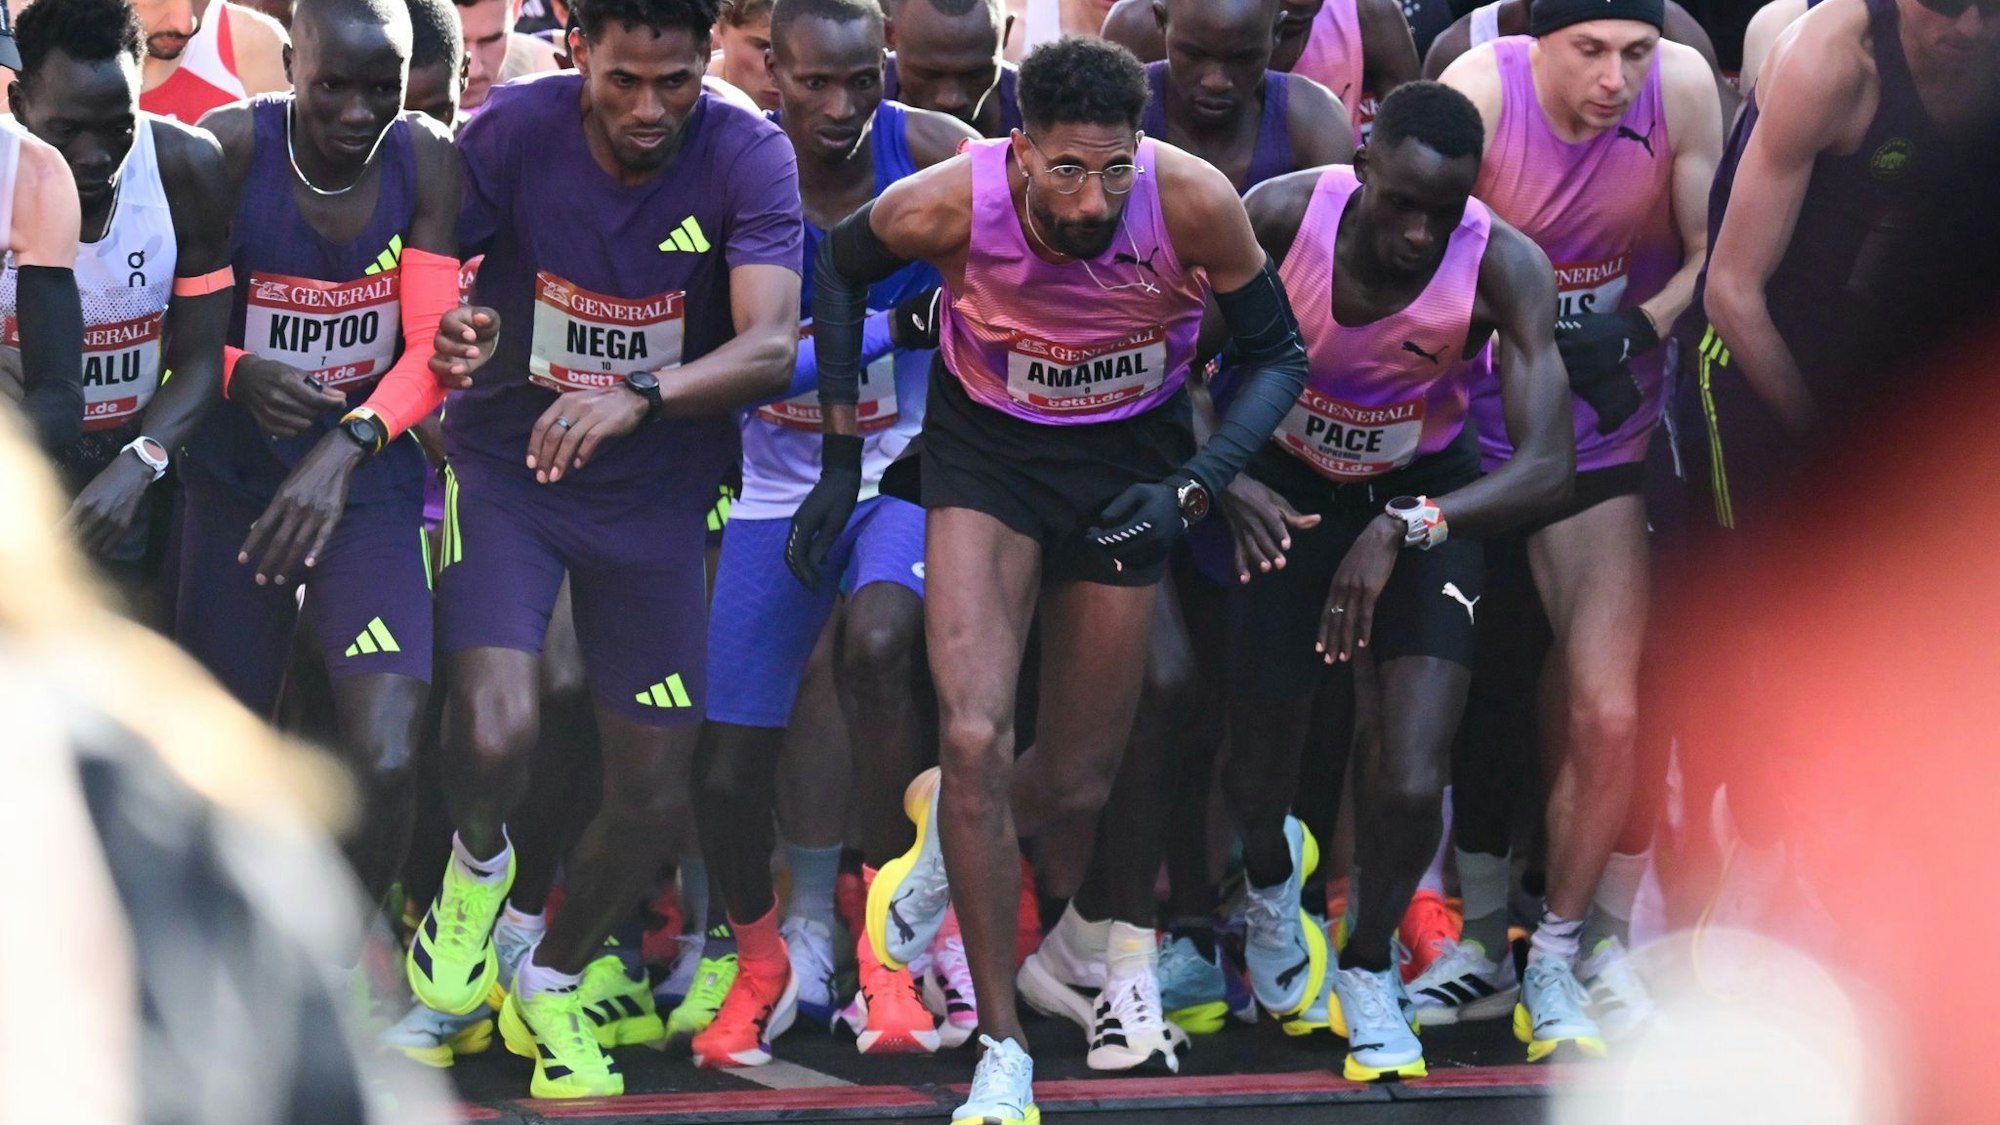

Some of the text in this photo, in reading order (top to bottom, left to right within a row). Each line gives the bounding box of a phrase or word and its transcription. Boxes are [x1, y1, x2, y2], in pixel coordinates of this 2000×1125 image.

[1554, 256, 1623, 286] NERALI
[291, 277, 393, 308] GENERALI
[570, 293, 674, 321] GENERALI
[83, 320, 152, 346] NERALI
[269, 310, 379, 353] KIPTOO
[566, 319, 648, 361] NEGA
[83, 349, 141, 387] ALU
[314, 365, 356, 382] t1.de
[567, 370, 614, 387] bett1
[601, 361, 611, 371] 10
[1027, 352, 1148, 388] AMANAL
[787, 405, 822, 419] bett
[1047, 390, 1125, 408] bett1.de
[1312, 396, 1416, 424] GENERALI
[1305, 414, 1384, 453] PACE
[1302, 444, 1374, 473] bett1.de
